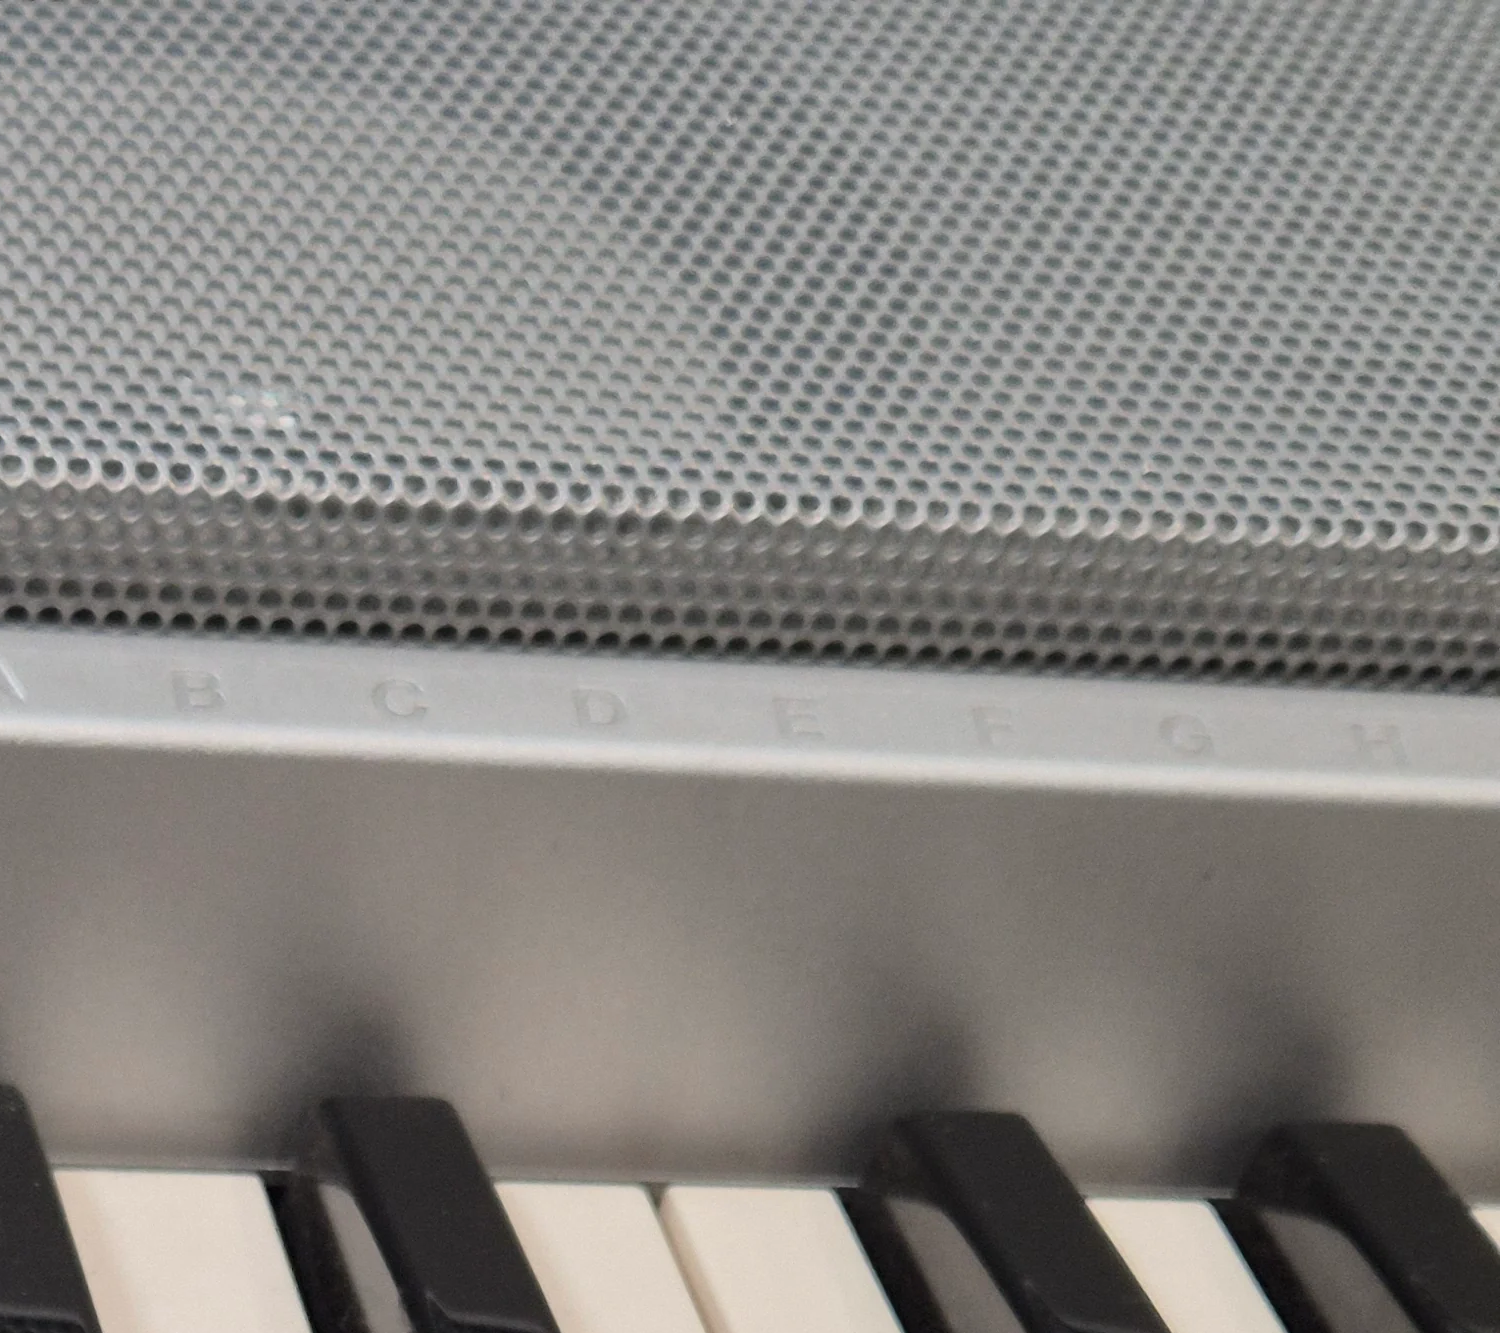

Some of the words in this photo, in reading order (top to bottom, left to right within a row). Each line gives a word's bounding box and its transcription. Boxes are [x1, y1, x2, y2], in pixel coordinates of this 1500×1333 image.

[171, 669, 227, 713] B
[370, 678, 429, 720] C
[572, 685, 630, 729] D
[772, 695, 825, 741] E
[970, 704, 1014, 748] F
[1159, 713, 1216, 757] G
[1349, 722, 1408, 763] H
